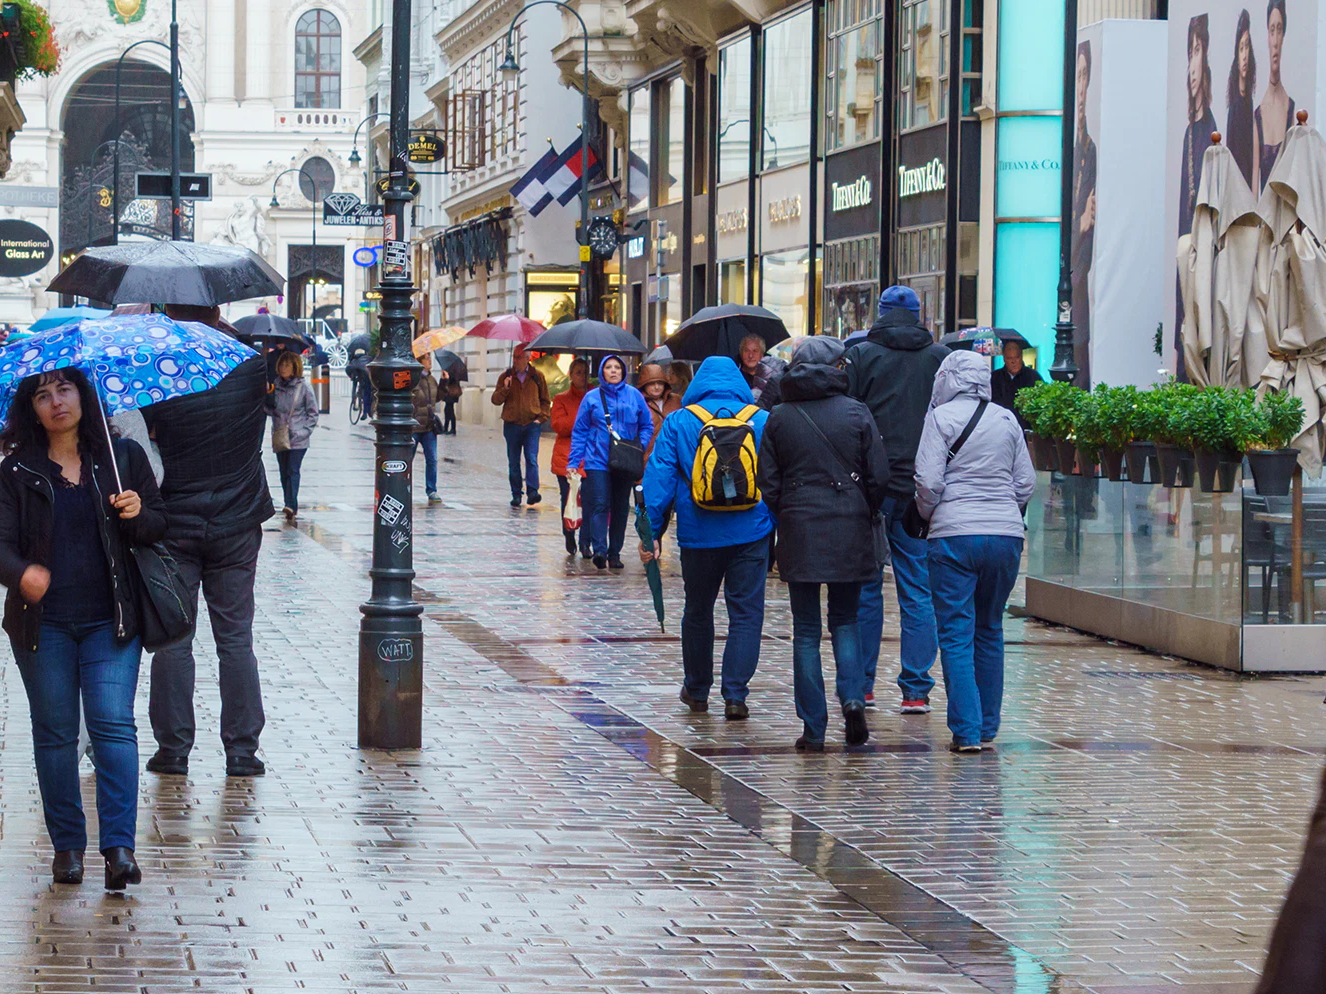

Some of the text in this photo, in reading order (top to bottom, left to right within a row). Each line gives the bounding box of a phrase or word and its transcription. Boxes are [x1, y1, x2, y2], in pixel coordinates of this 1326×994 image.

[408, 142, 437, 151] DEMEL
[0, 239, 50, 248] International
[5, 249, 30, 259] Glass
[31, 250, 45, 259] Art
